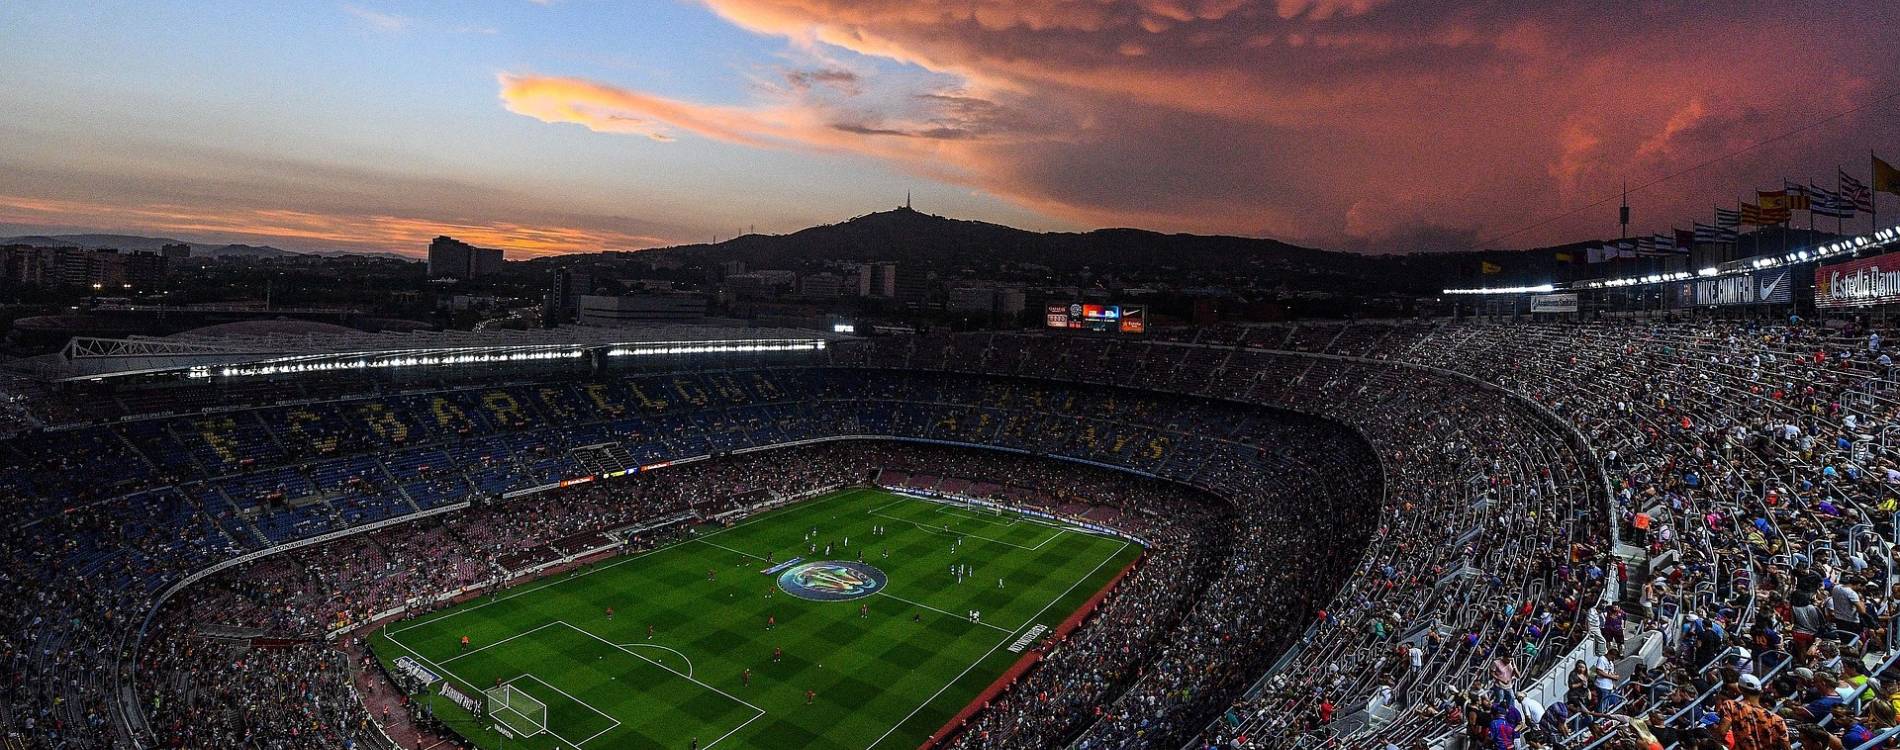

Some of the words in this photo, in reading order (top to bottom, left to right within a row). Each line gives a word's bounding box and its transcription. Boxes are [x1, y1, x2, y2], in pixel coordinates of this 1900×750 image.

[1697, 276, 1754, 305] NIKE.COM/FCB
[1831, 268, 1869, 300] Estrella
[274, 540, 305, 552] KONAMI
[349, 523, 376, 534] KONAMI
